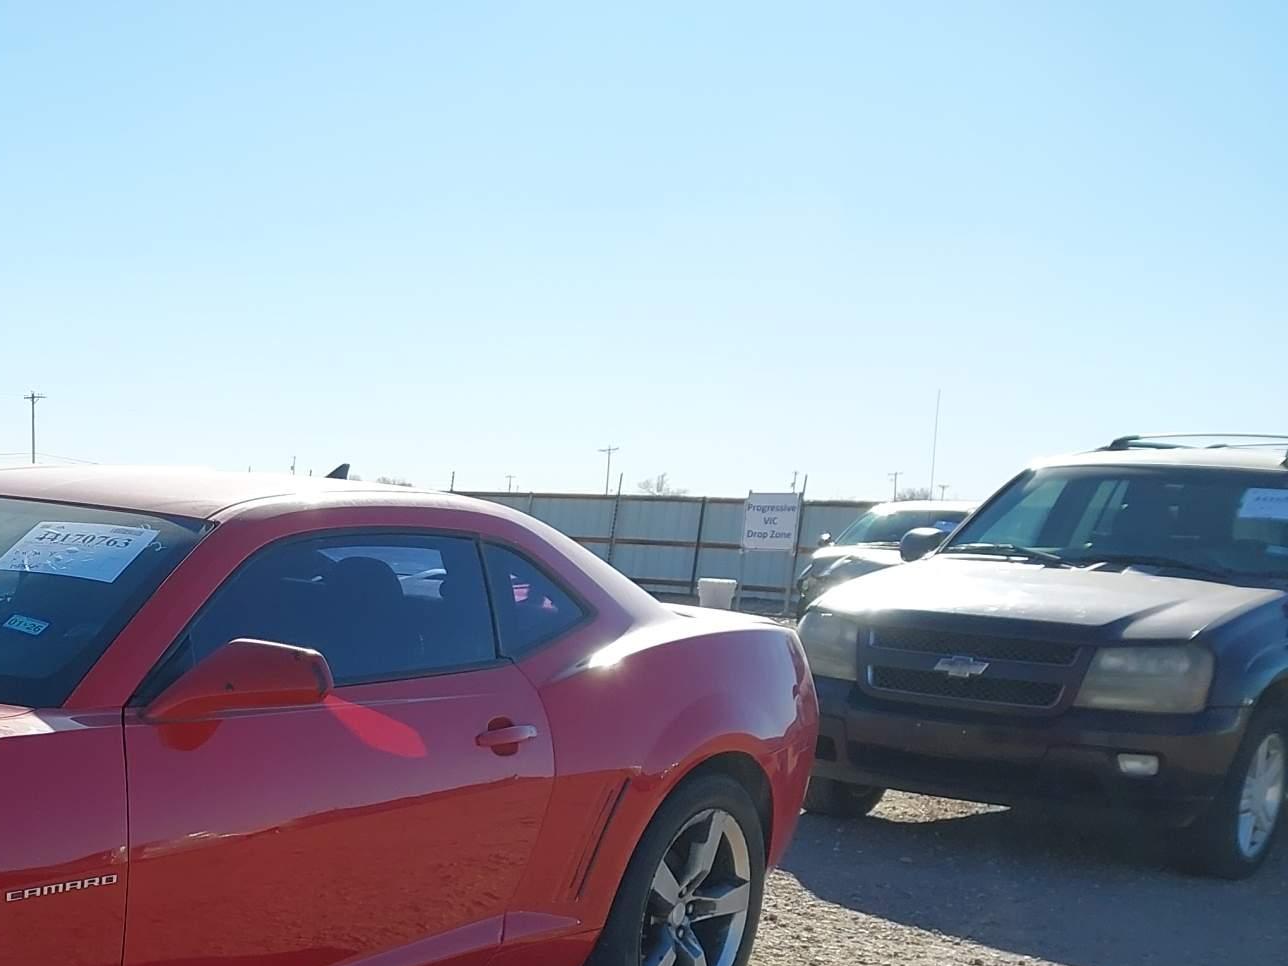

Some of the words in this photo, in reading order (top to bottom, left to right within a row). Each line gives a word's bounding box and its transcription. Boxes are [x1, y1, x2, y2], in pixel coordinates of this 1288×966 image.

[747, 503, 796, 513] Progressive
[36, 531, 132, 548] 44170763
[746, 530, 768, 539] Drop
[769, 530, 792, 539] Zone
[6, 874, 118, 902] CAMARO
